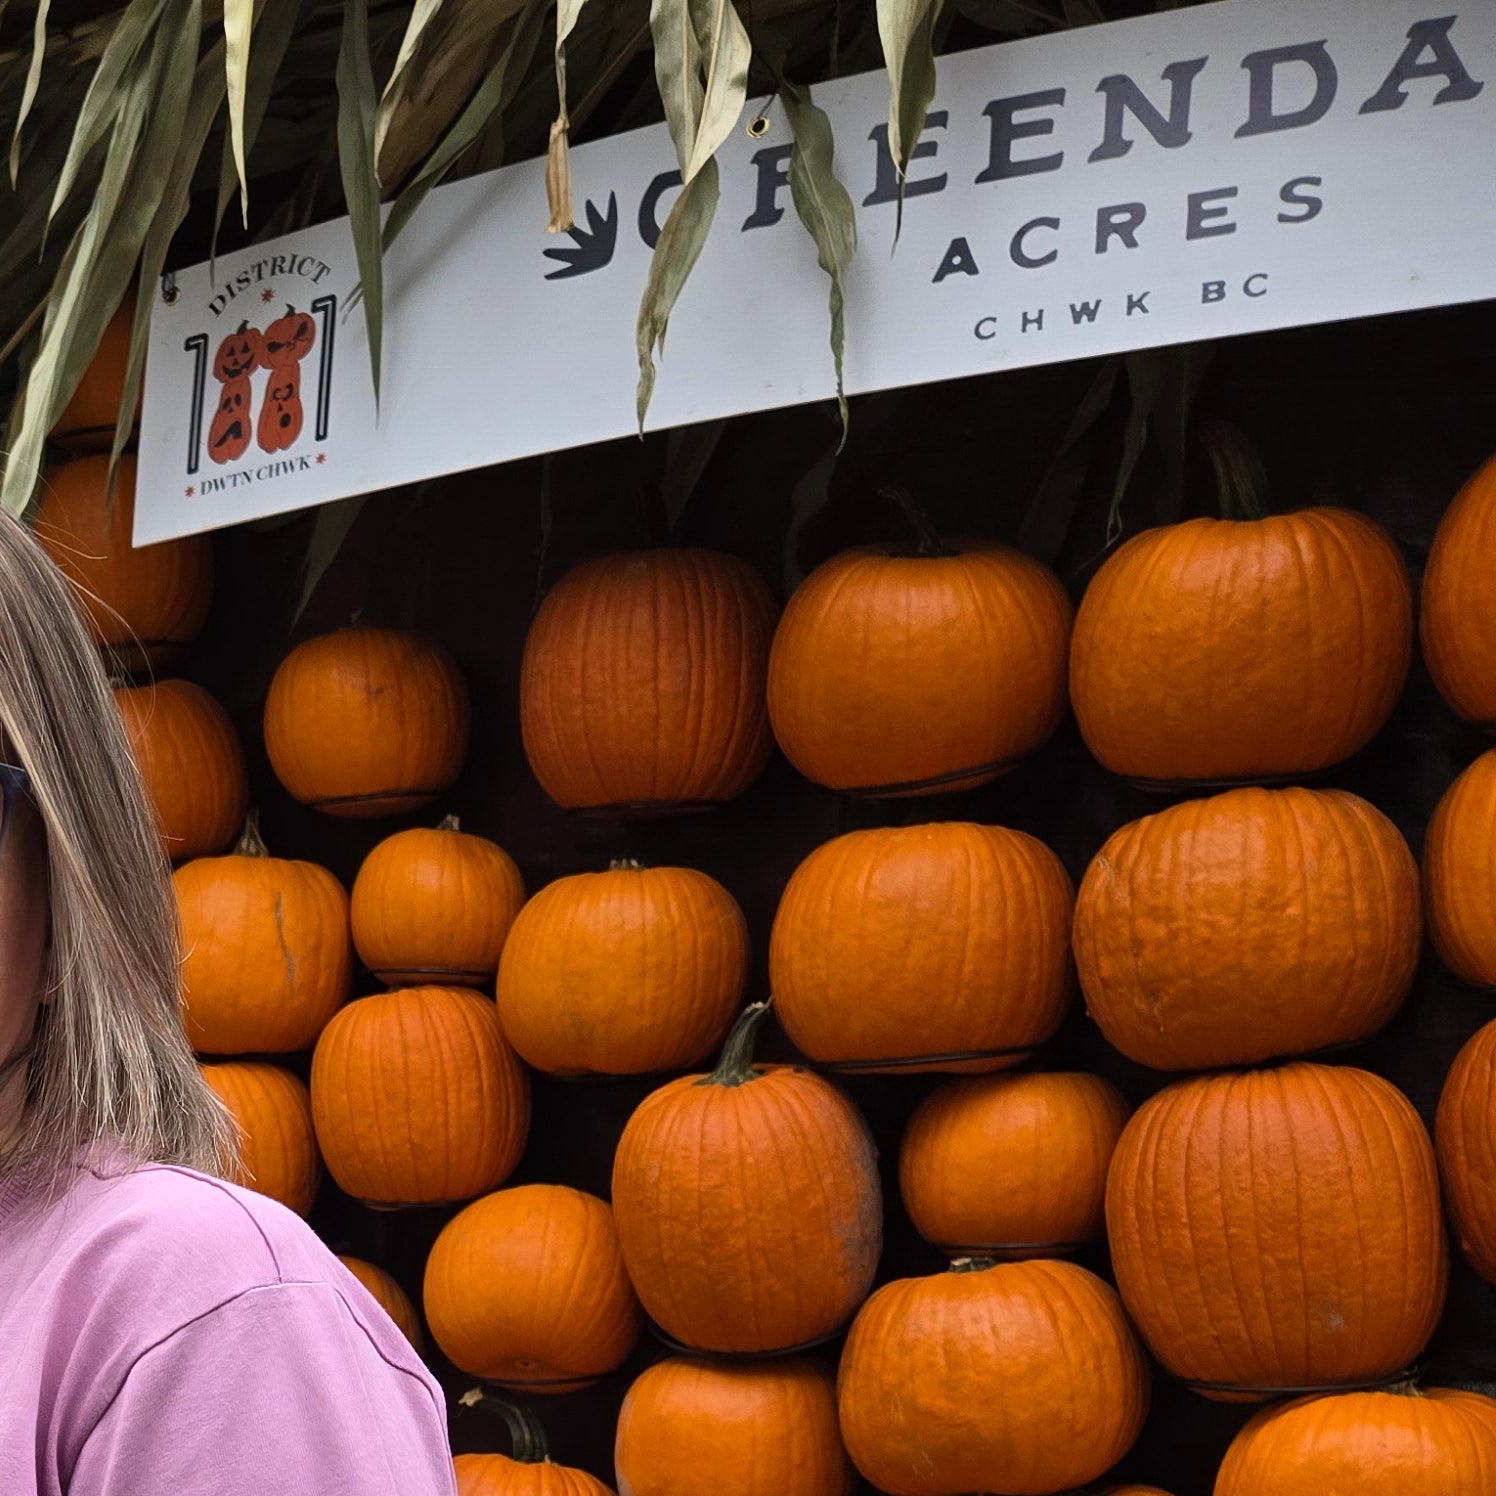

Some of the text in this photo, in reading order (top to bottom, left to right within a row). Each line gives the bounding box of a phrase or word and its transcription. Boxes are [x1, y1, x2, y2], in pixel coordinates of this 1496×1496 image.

[931, 175, 1324, 284] ACRES
[206, 253, 332, 319] DISTRICT
[973, 273, 1269, 340] CHWK BC
[199, 453, 314, 496] DWTN CHWK
